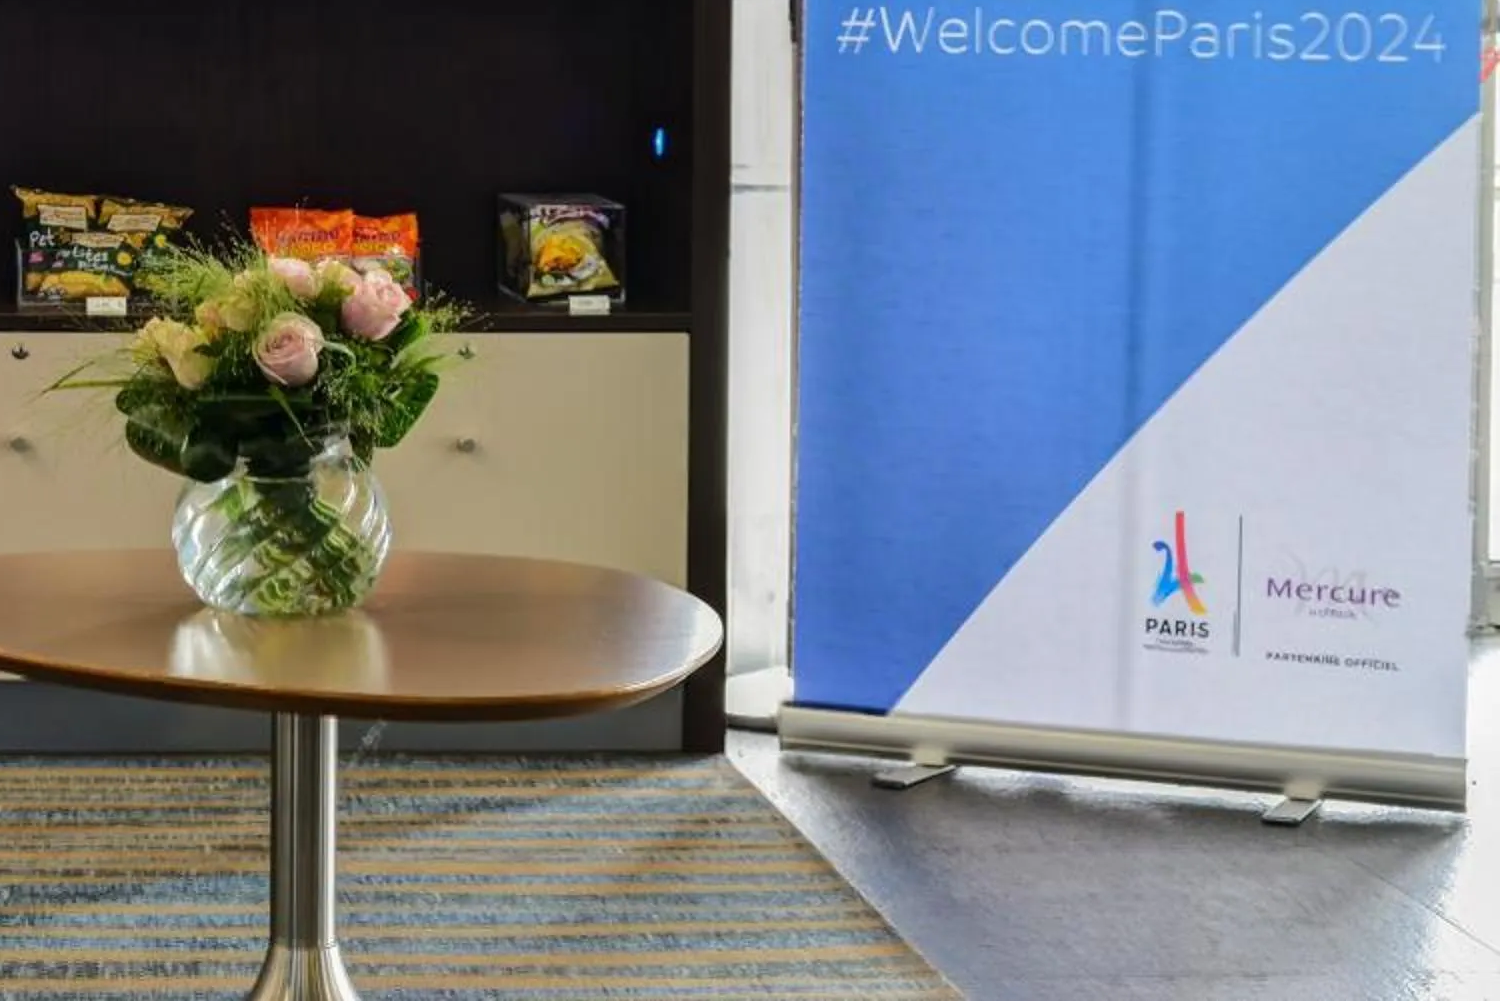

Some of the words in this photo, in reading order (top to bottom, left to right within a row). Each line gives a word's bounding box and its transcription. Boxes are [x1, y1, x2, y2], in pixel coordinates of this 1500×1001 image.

[836, 5, 1447, 62] #WelcomeParis2024
[1267, 577, 1401, 608] Mercure
[1145, 618, 1209, 639] PARIS
[1266, 651, 1340, 667] PARTENAIRE
[1343, 657, 1401, 672] OFFICIEL
